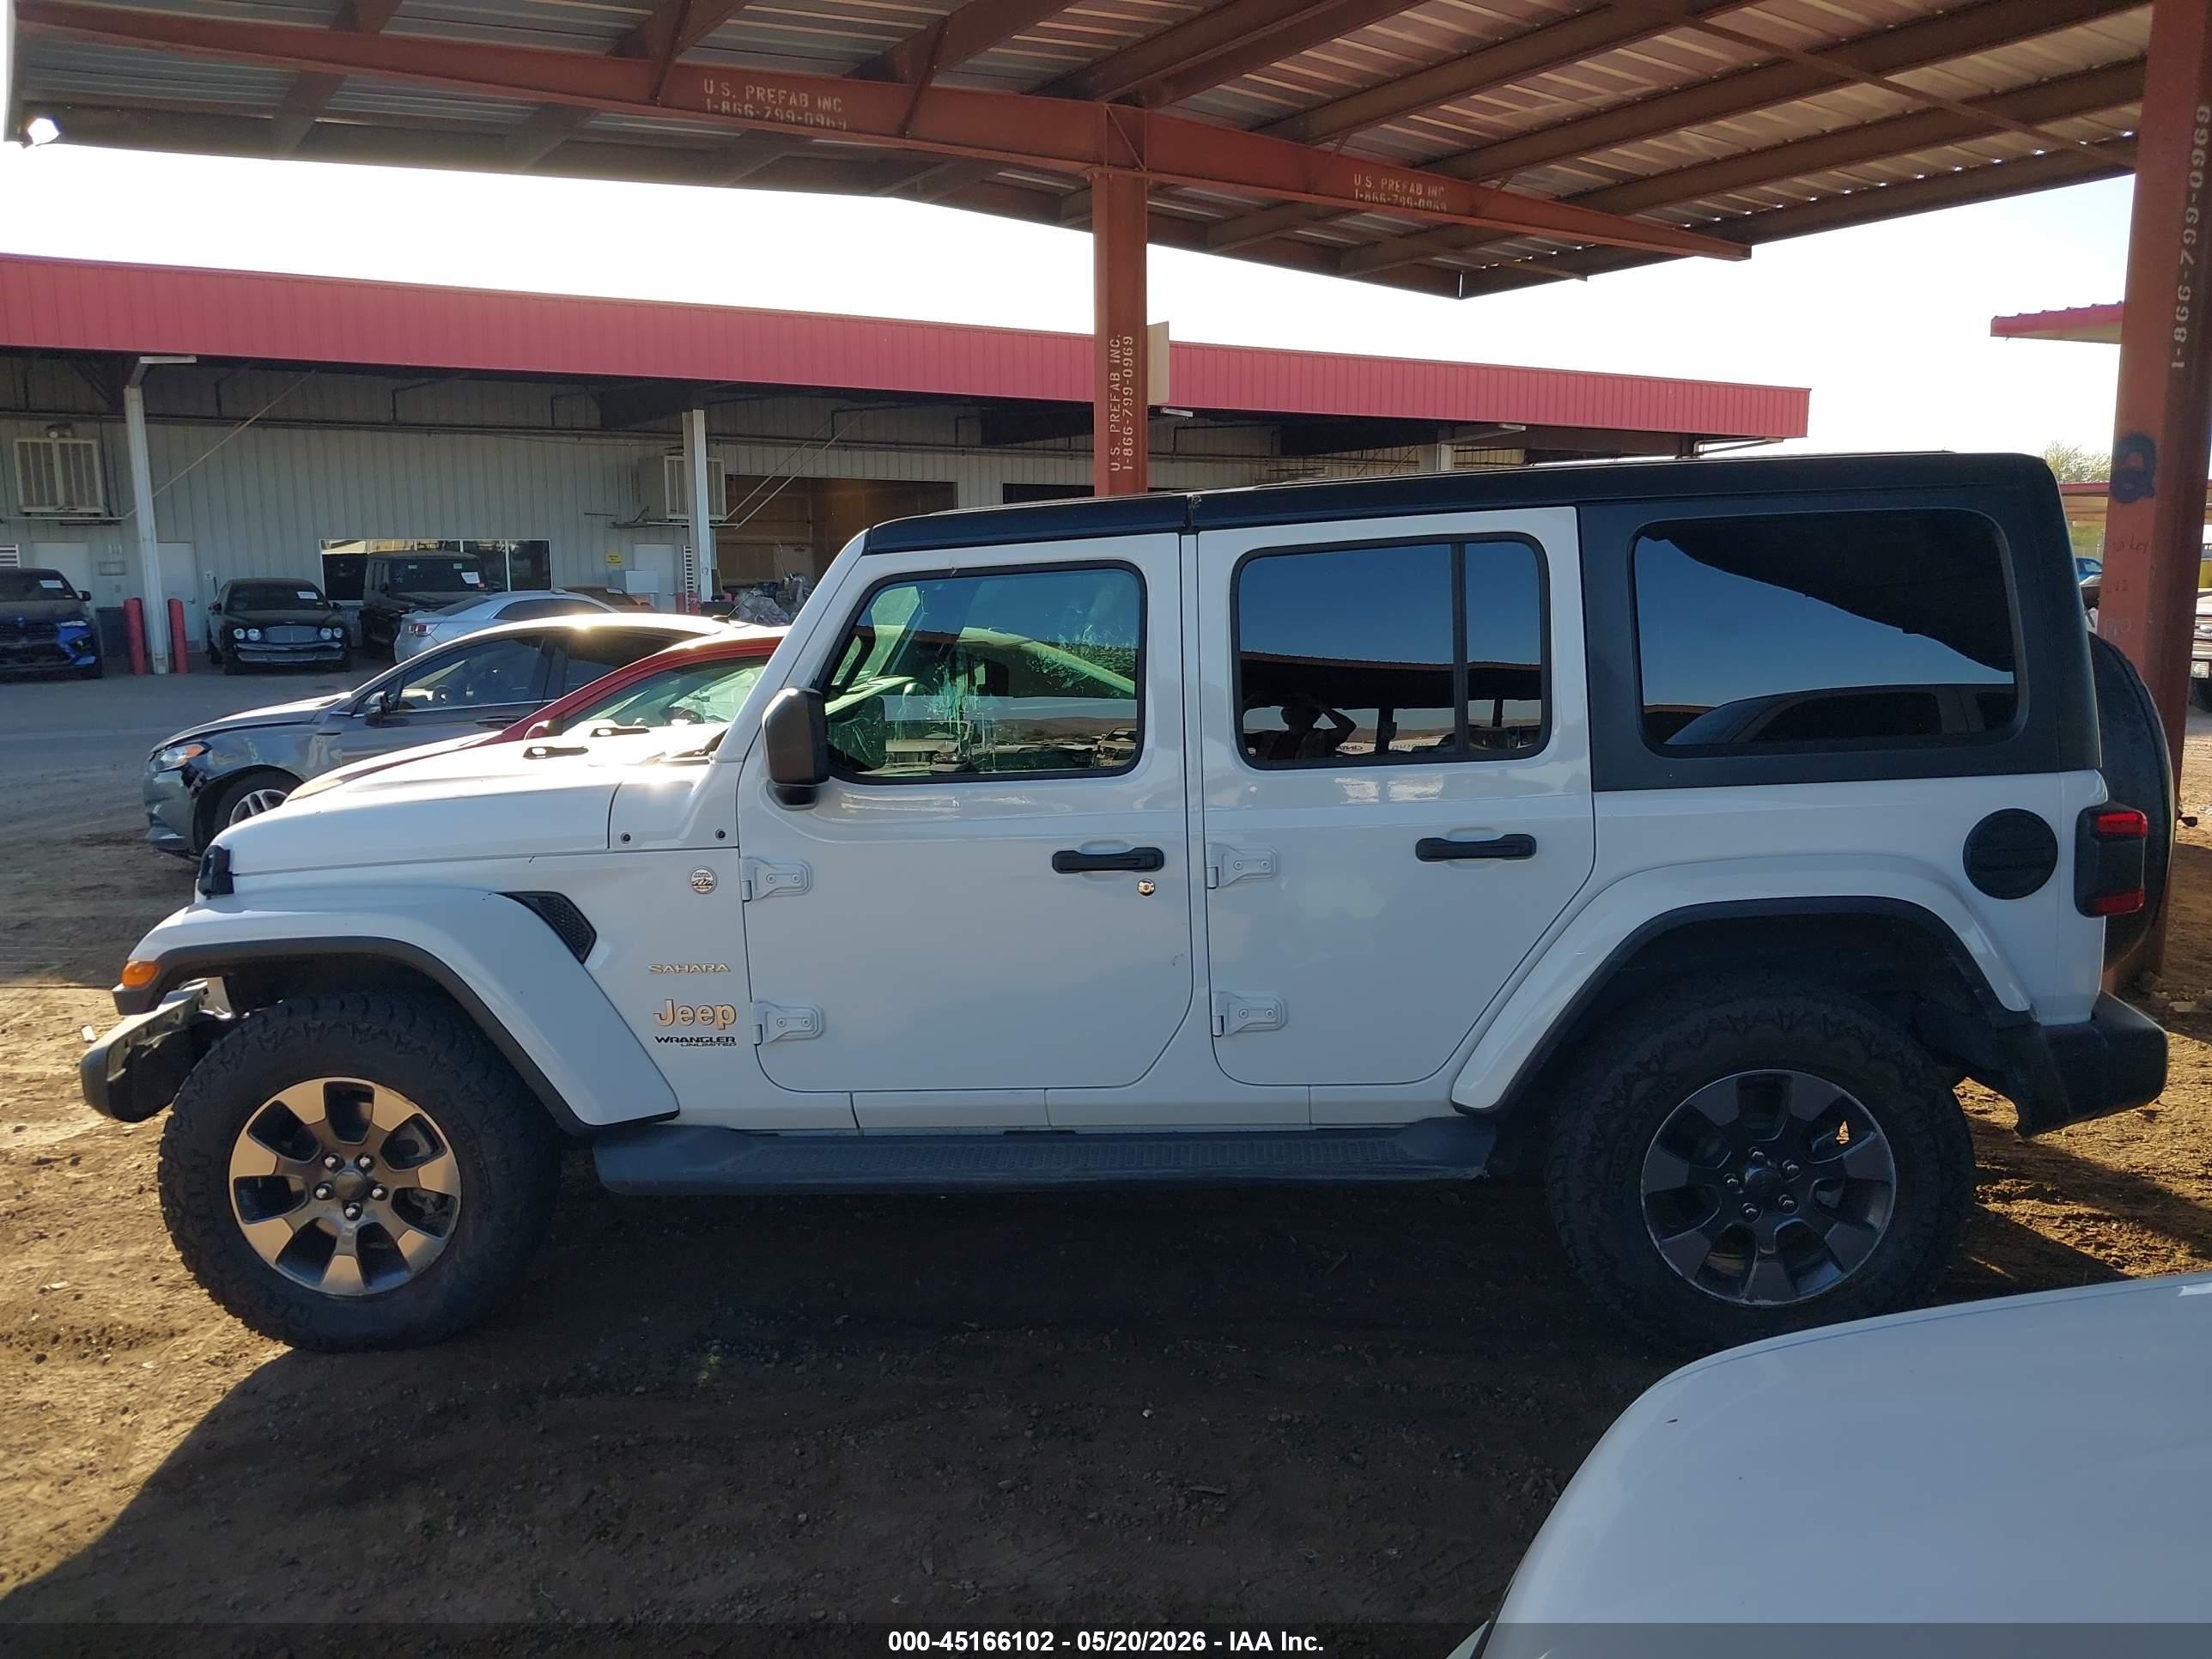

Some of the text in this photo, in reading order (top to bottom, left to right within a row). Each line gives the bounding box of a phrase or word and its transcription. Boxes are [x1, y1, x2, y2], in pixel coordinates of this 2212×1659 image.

[745, 84, 809, 108] PREFAB
[1381, 178, 1423, 196] PREFAB
[2171, 105, 2211, 368] 1-866-799-0969
[1109, 334, 1121, 471] U.S. PREFAB INC.
[1122, 336, 1133, 471] 1-866-799-0969
[647, 963, 731, 974] SAHARA
[653, 998, 737, 1030] Jeep
